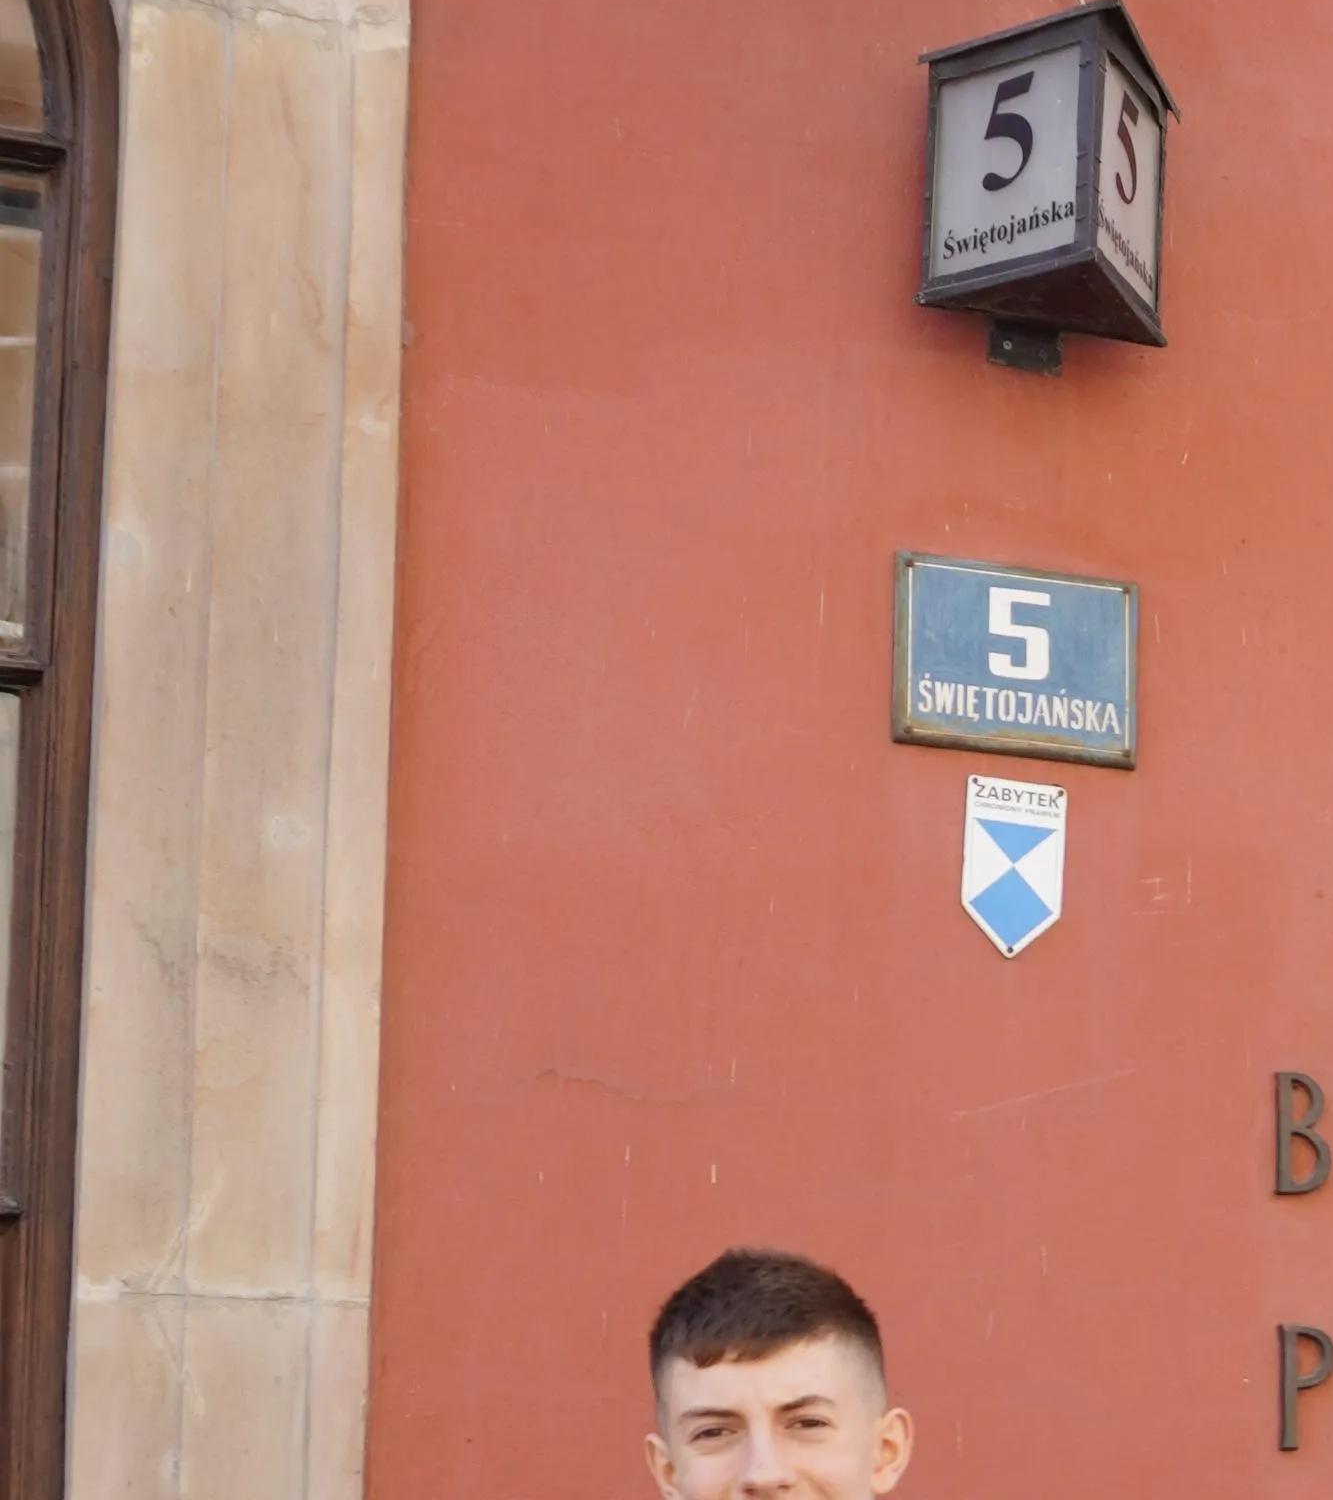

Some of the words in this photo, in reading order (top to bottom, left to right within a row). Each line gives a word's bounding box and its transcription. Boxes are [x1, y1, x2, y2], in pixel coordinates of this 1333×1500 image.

[982, 70, 1035, 192] 5
[1115, 89, 1139, 205] 5
[942, 199, 1075, 260] Świętojańska
[988, 586, 1051, 680] 5
[918, 673, 1121, 735] ŚWIĘTOJAŃSKA
[975, 784, 1060, 809] ZABYTEK
